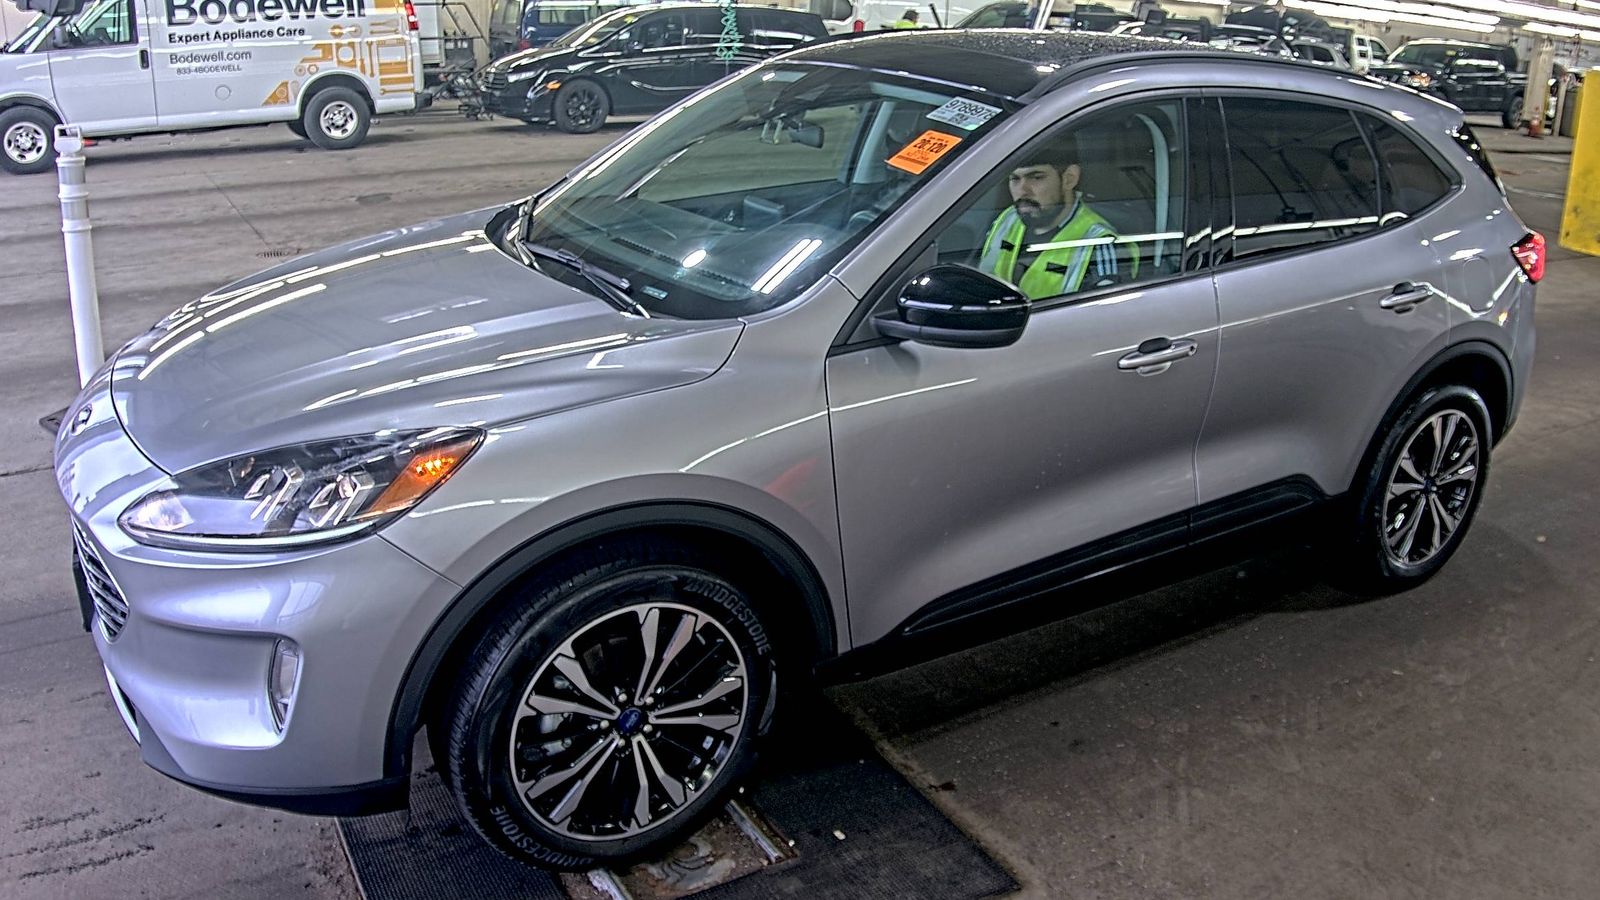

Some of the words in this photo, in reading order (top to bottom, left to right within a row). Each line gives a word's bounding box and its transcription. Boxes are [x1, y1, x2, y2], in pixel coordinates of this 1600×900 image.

[168, 32, 211, 44] Expert
[213, 28, 274, 42] Appliance
[276, 26, 305, 37] Care
[169, 51, 252, 64] Bodewell.com
[682, 579, 772, 655] BRIDGESTONE
